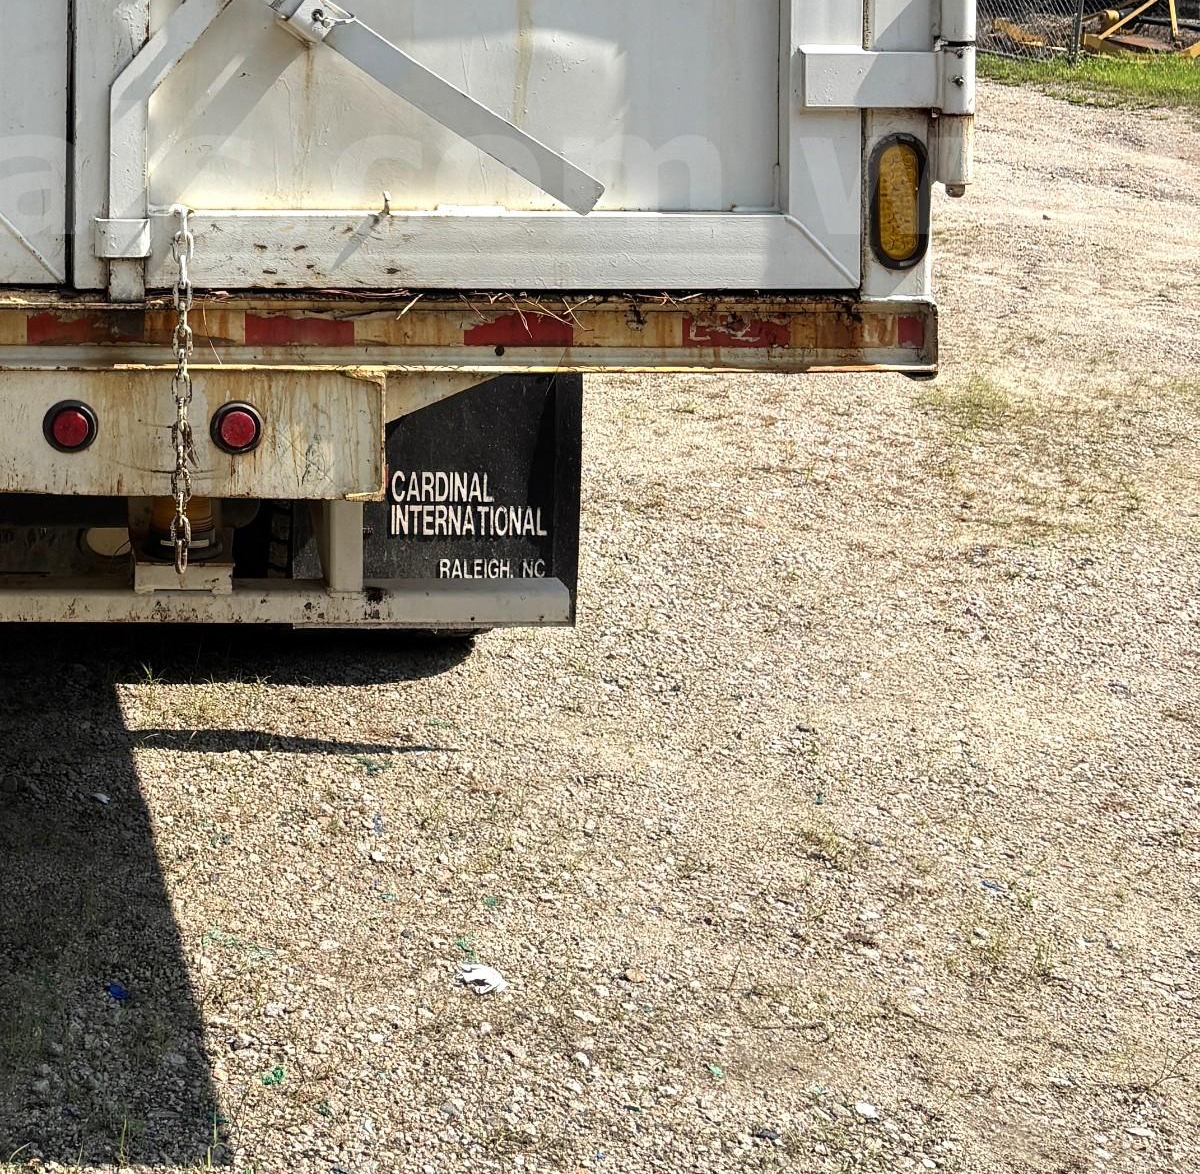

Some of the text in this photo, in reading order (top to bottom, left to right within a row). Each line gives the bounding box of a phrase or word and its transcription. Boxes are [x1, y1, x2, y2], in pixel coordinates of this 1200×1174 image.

[391, 470, 495, 503] CARDINAL
[391, 505, 548, 537] INTERNATIONAL
[522, 558, 546, 578] NC
